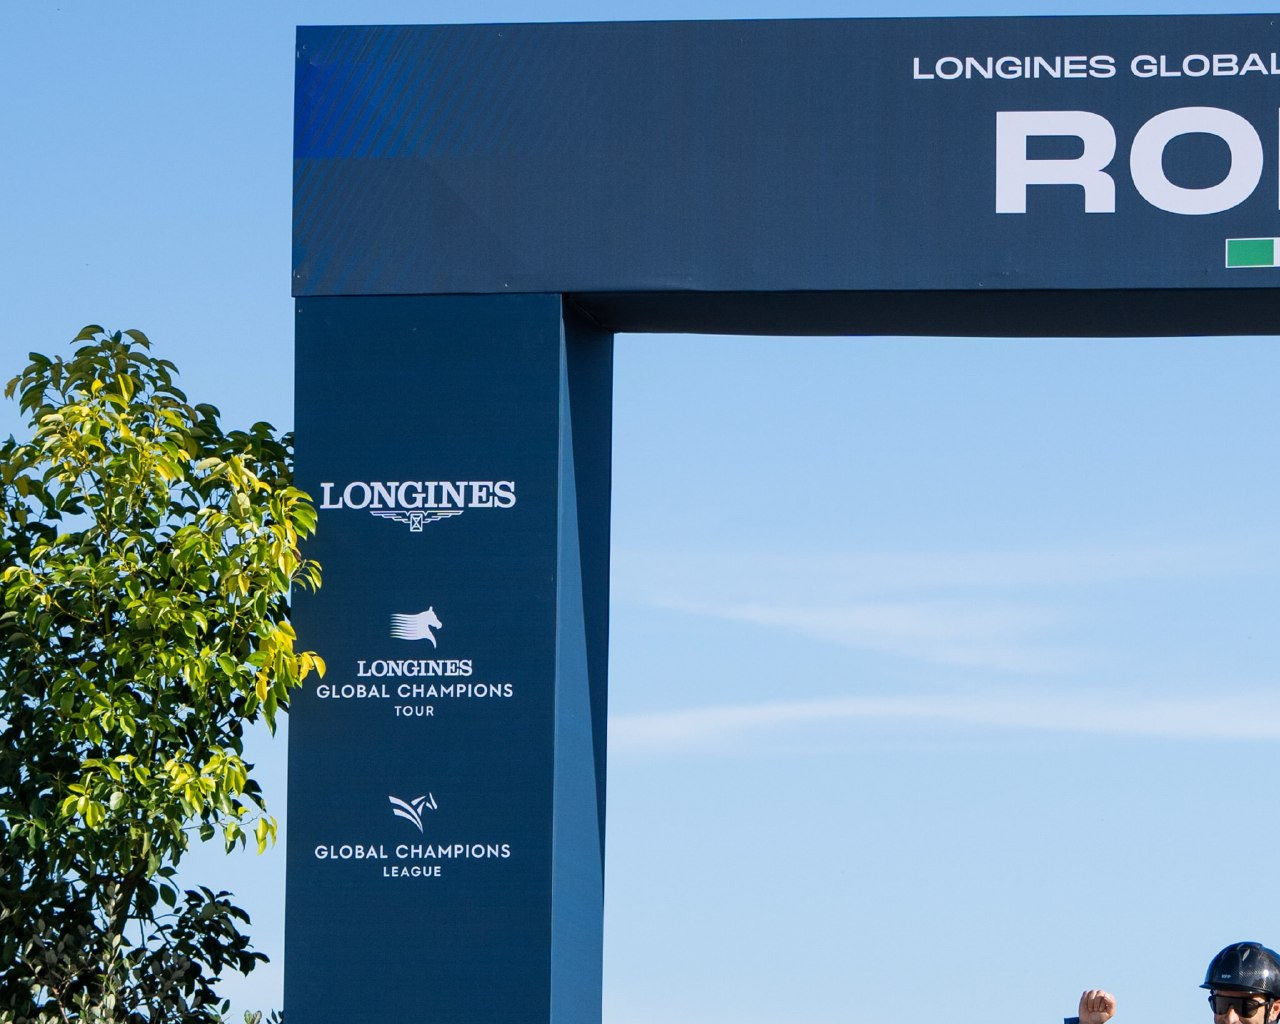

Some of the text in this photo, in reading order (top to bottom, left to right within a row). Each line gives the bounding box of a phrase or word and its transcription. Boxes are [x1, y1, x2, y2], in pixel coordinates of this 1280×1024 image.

[913, 54, 1117, 80] LONGINES
[320, 480, 516, 509] LONGINES
[356, 659, 473, 677] LONGINES
[316, 683, 514, 699] GLOBAL CHAMPIONS
[394, 705, 434, 717] TOUR
[314, 843, 511, 860] GLOBAL CHAMPIONS
[383, 866, 442, 878] LEAGUE
